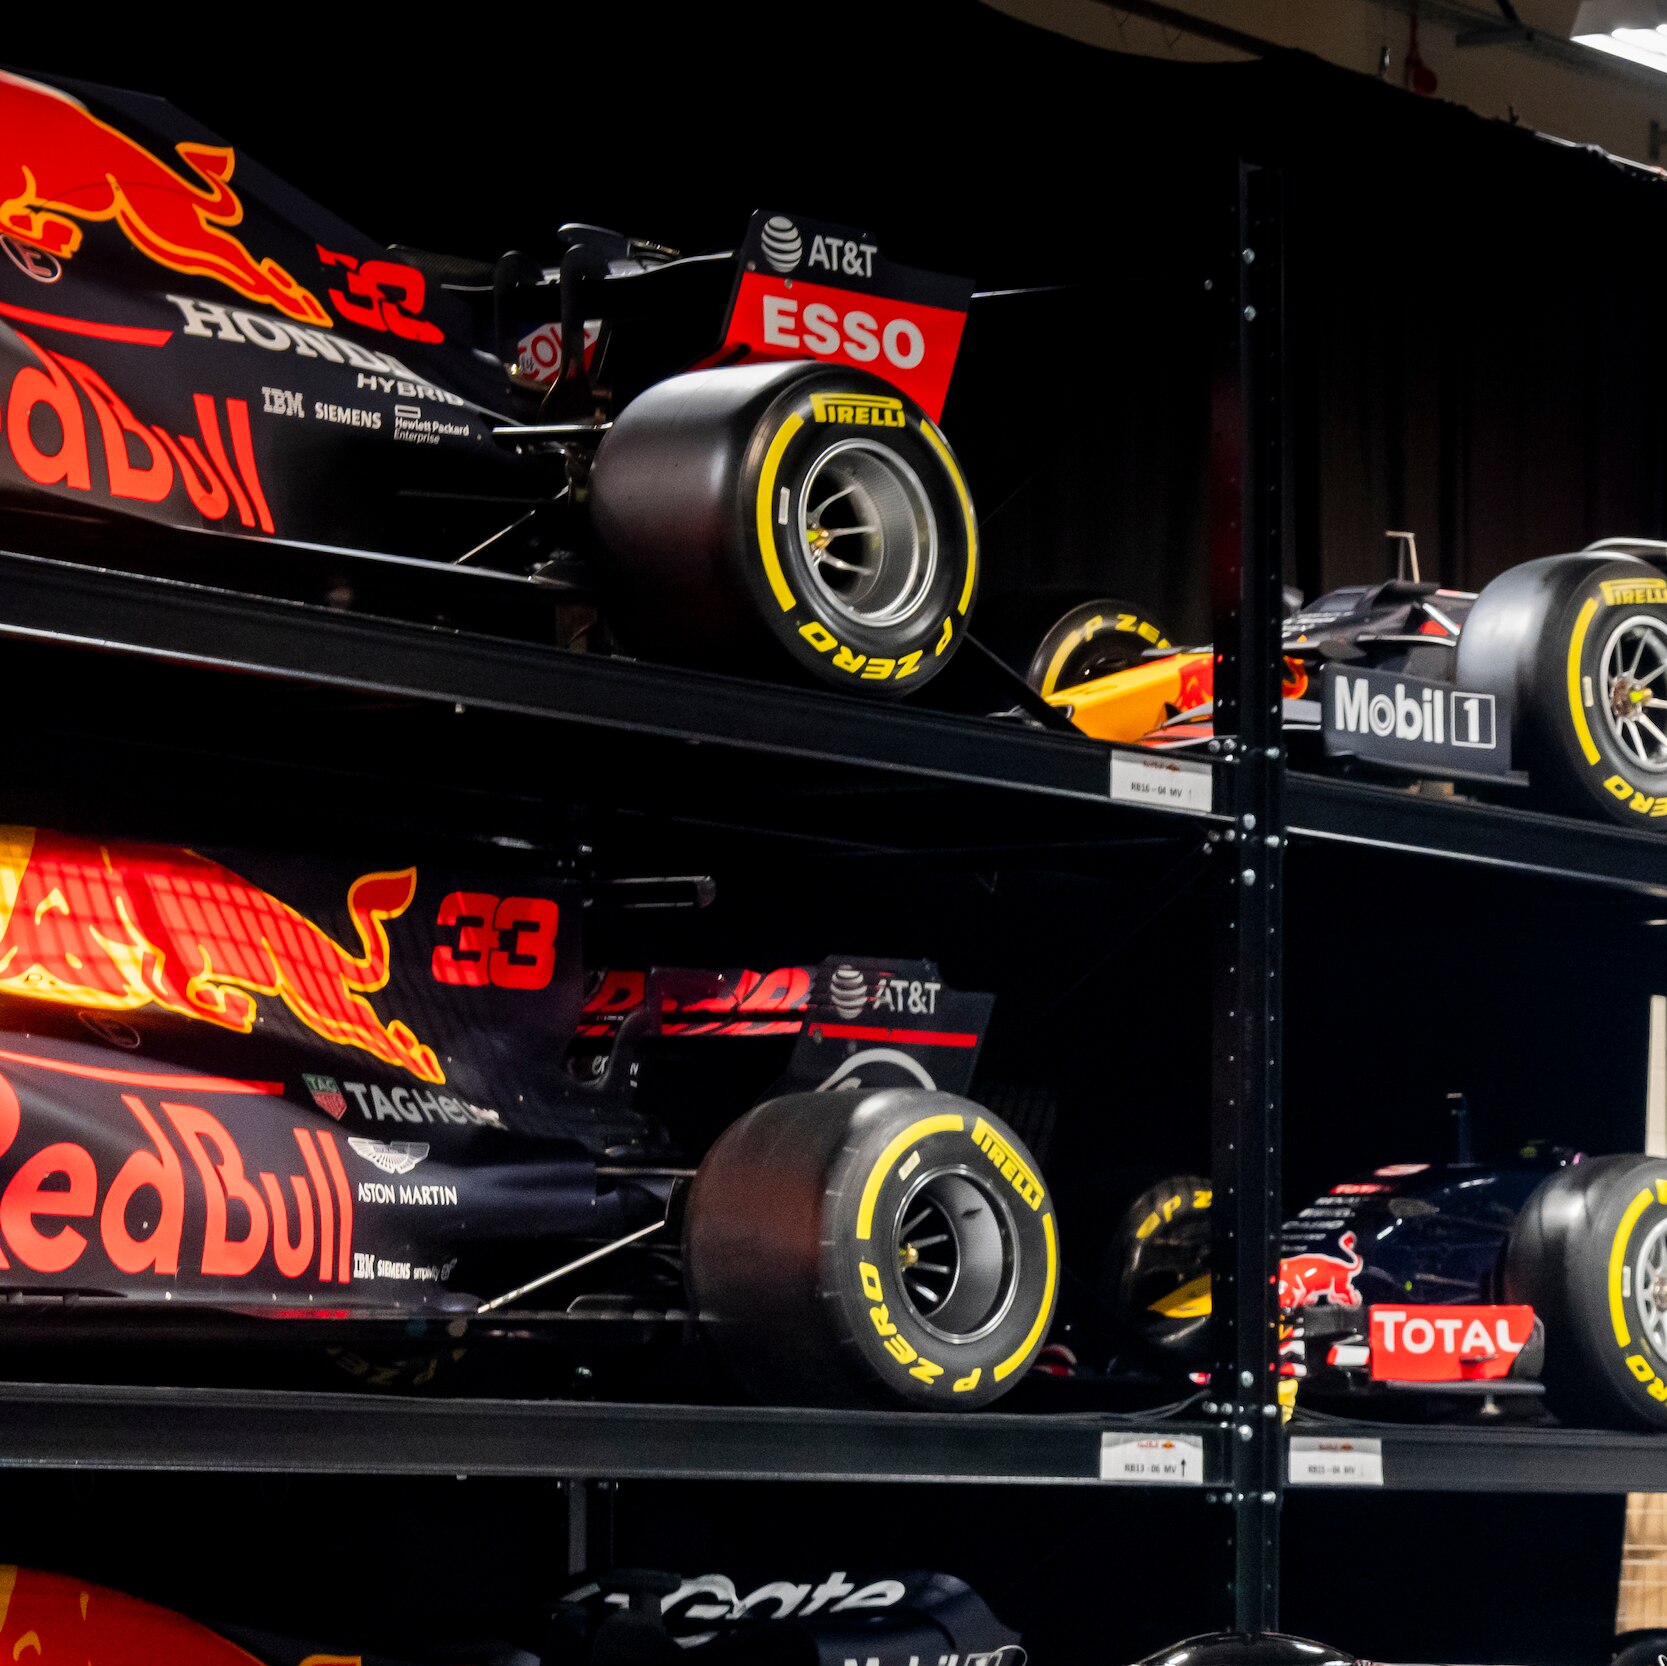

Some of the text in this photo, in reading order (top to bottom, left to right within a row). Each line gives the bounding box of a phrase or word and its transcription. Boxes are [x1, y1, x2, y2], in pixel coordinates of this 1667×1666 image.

[808, 235, 877, 278] AT&T
[763, 294, 925, 370] ESSO
[262, 387, 304, 418] IBM
[357, 373, 464, 406] HYBRID
[315, 402, 381, 429] SIEMENS
[810, 393, 905, 427] PIRELLI
[0, 330, 275, 534] dBull
[394, 417, 470, 437] Hewlett Packard
[394, 431, 440, 444] Enterprise
[1083, 614, 1103, 642] P
[799, 616, 953, 680] P ZERO
[1335, 675, 1444, 743] Mobil
[1170, 786, 1182, 797] MV
[434, 893, 559, 989] 33
[874, 979, 941, 1014] AT&T
[971, 1117, 1046, 1212] PIRELLI
[358, 1182, 457, 1206] ASTON MARTIN
[1163, 1194, 1182, 1223] P
[353, 1253, 375, 1280] IBM
[377, 1259, 411, 1280] SIEMENS
[859, 1262, 983, 1392] P ZERO
[1374, 1312, 1523, 1354] TOTAL
[1124, 1463, 1145, 1473] RB13
[1164, 1465, 1177, 1474] MV
